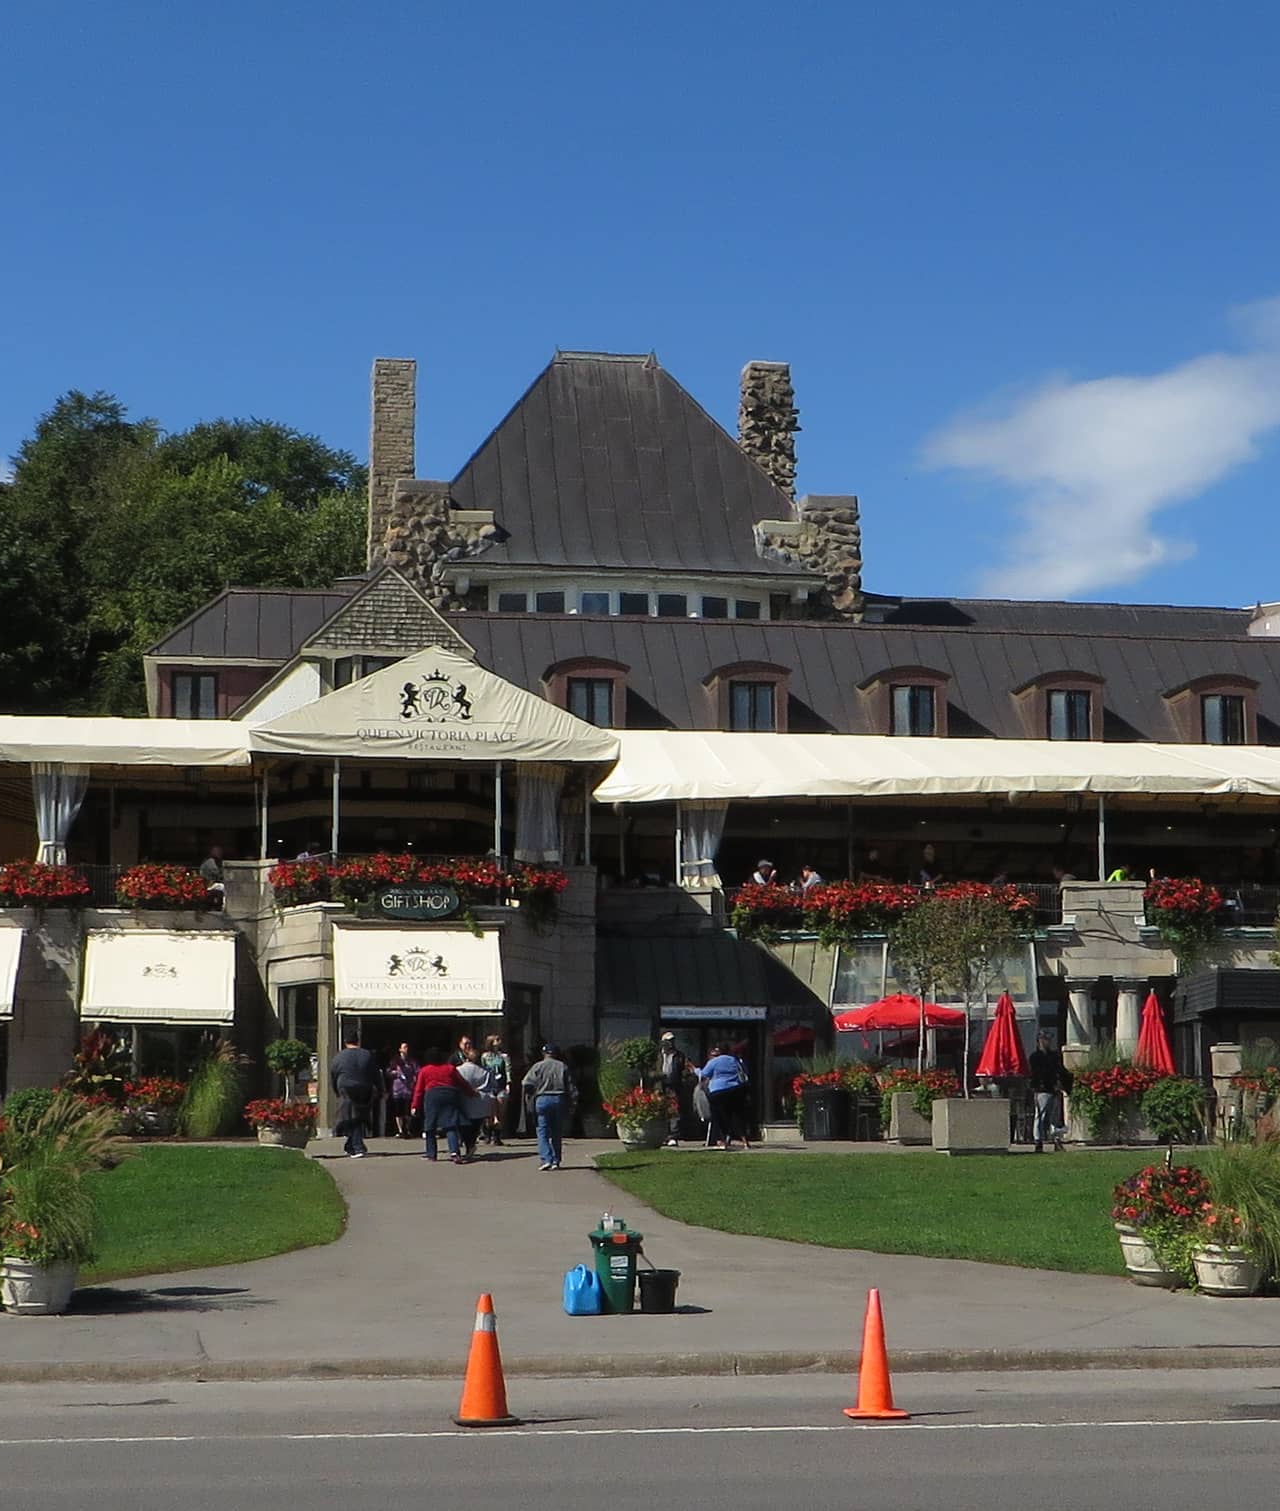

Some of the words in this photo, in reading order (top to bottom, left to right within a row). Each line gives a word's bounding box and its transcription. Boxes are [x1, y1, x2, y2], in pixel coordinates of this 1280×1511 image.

[356, 728, 406, 739] QUEEN
[407, 729, 471, 742] VICTORIA
[475, 731, 517, 743] PLACE
[381, 894, 410, 909] GIFT
[412, 895, 450, 910] SHOP
[350, 982, 392, 991] QUEEN
[393, 983, 449, 991] VICTORIA
[452, 983, 487, 991] PLACE
